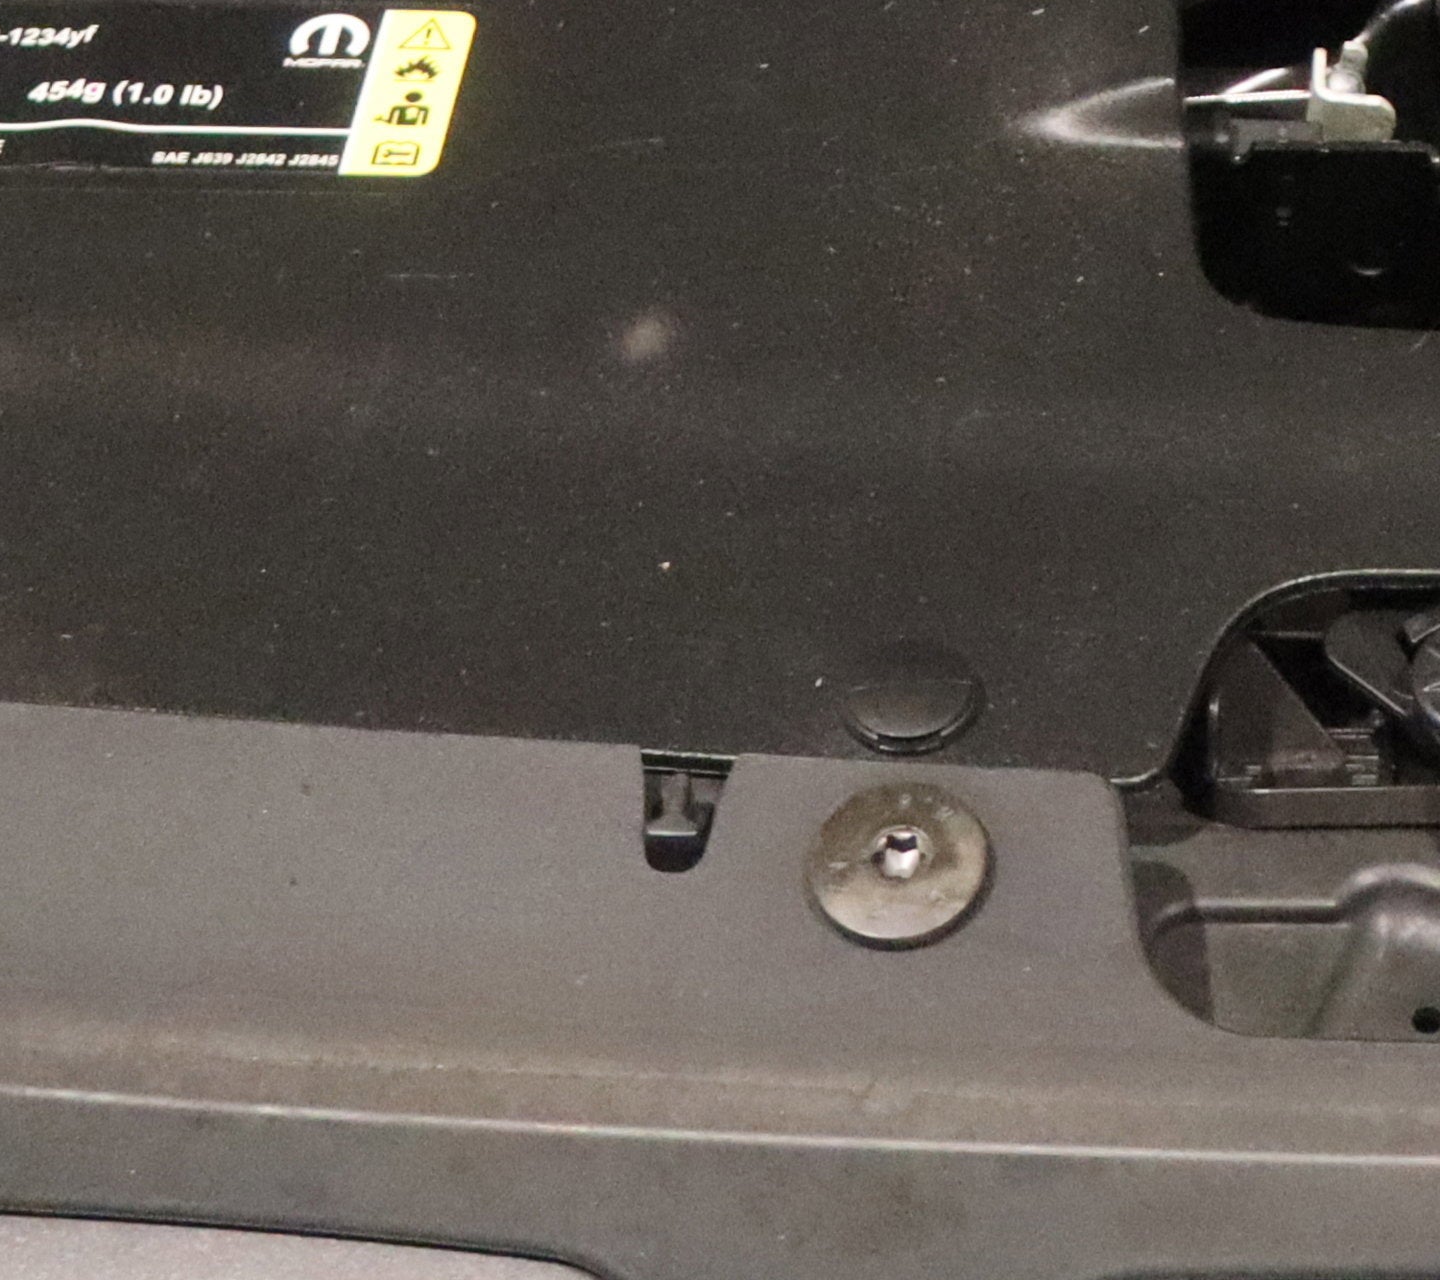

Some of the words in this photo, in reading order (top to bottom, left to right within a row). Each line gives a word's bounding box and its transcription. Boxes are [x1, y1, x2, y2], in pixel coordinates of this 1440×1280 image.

[27, 78, 106, 104] 454g
[113, 80, 175, 107] (1.0
[179, 84, 224, 111] lb)
[152, 151, 191, 164] SAE
